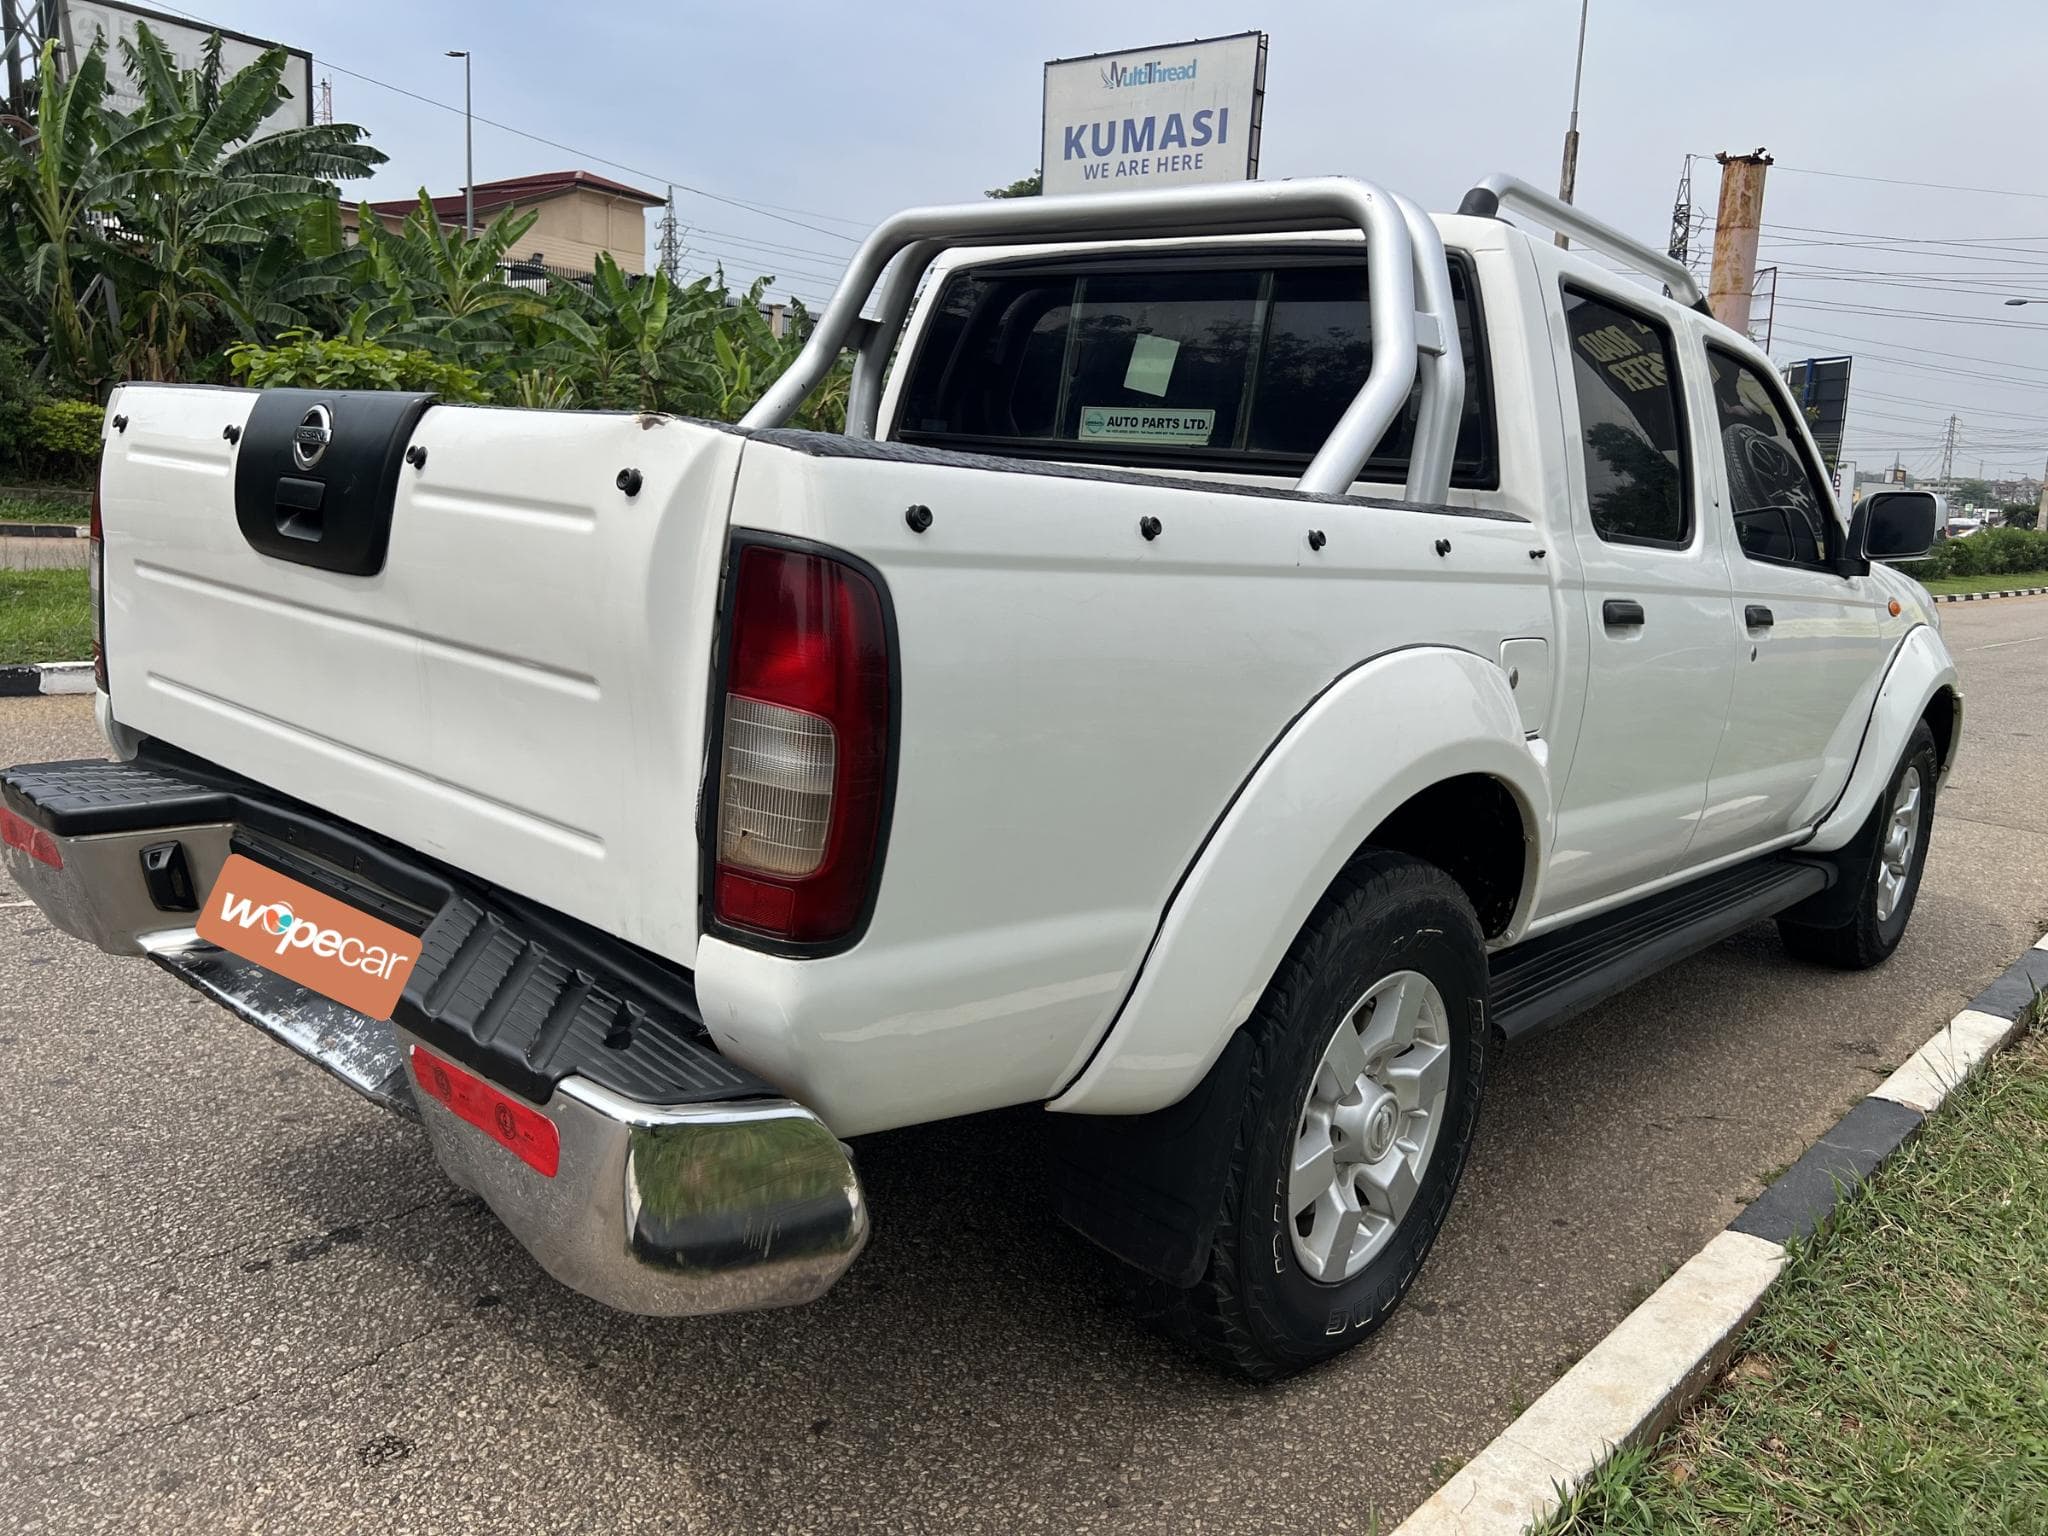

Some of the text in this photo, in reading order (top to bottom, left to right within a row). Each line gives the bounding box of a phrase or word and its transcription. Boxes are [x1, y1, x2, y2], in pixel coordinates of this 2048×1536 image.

[1110, 59, 1197, 88] MultiThread
[1064, 108, 1228, 160] KUMASI
[1084, 153, 1204, 180] WE ARE HERE
[1107, 416, 1139, 428] AUTO
[1142, 417, 1180, 429] PARTS
[1183, 418, 1209, 430] LTD.
